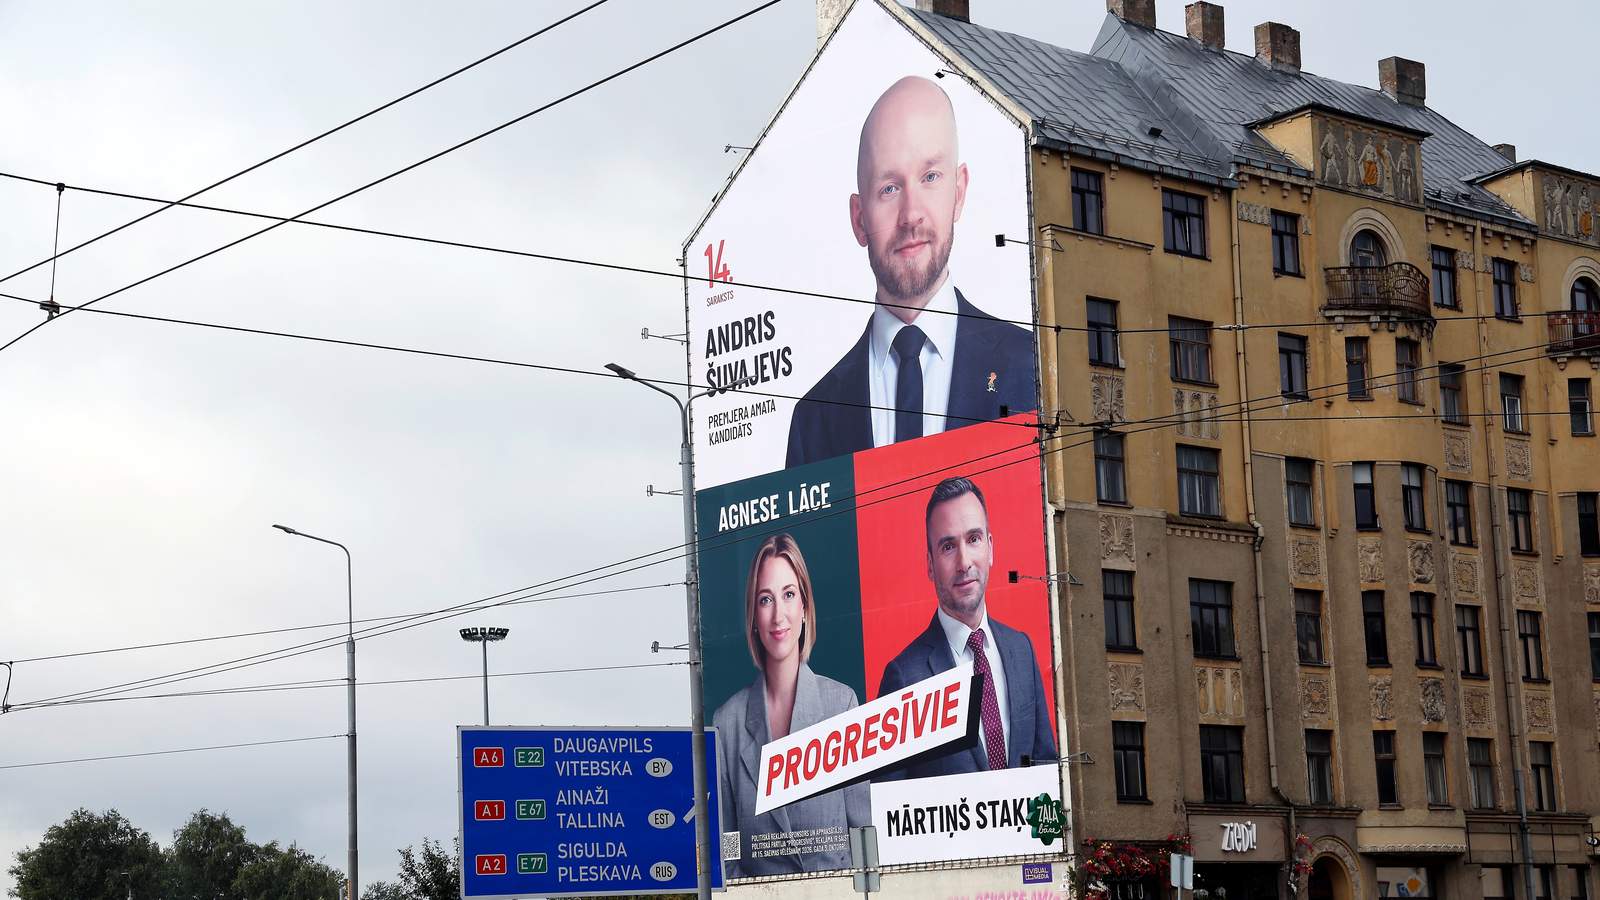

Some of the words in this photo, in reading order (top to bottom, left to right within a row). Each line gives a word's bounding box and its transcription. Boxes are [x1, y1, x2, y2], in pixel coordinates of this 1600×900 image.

[704, 239, 733, 288] 14.
[706, 290, 734, 307] SARAKSTS
[705, 310, 776, 359] ANDRIS
[706, 346, 793, 398] ŠUVAJEVS
[708, 404, 749, 429] PREMJERA
[750, 399, 776, 419] AMATA
[709, 421, 752, 446] KANDIDĀTS
[718, 494, 780, 532] AGNESE
[788, 482, 831, 515] LĀCE
[554, 737, 653, 754] DAUGAVPILS
[766, 681, 961, 796] PROGRESĪVIE
[528, 752, 541, 763] 22
[555, 760, 633, 777] VITEBSKA
[652, 762, 666, 773] BY
[556, 785, 609, 806] AINAŽI
[530, 804, 542, 816] 67
[886, 797, 971, 838] MĀRTIŅŠ
[976, 796, 1039, 832] STAĶ
[556, 812, 625, 829] TALLINA
[654, 813, 670, 825] EST
[558, 842, 628, 859] SIGULDA
[531, 857, 544, 870] 77
[558, 865, 642, 883] PLESKAVA
[655, 865, 673, 878] RUS
